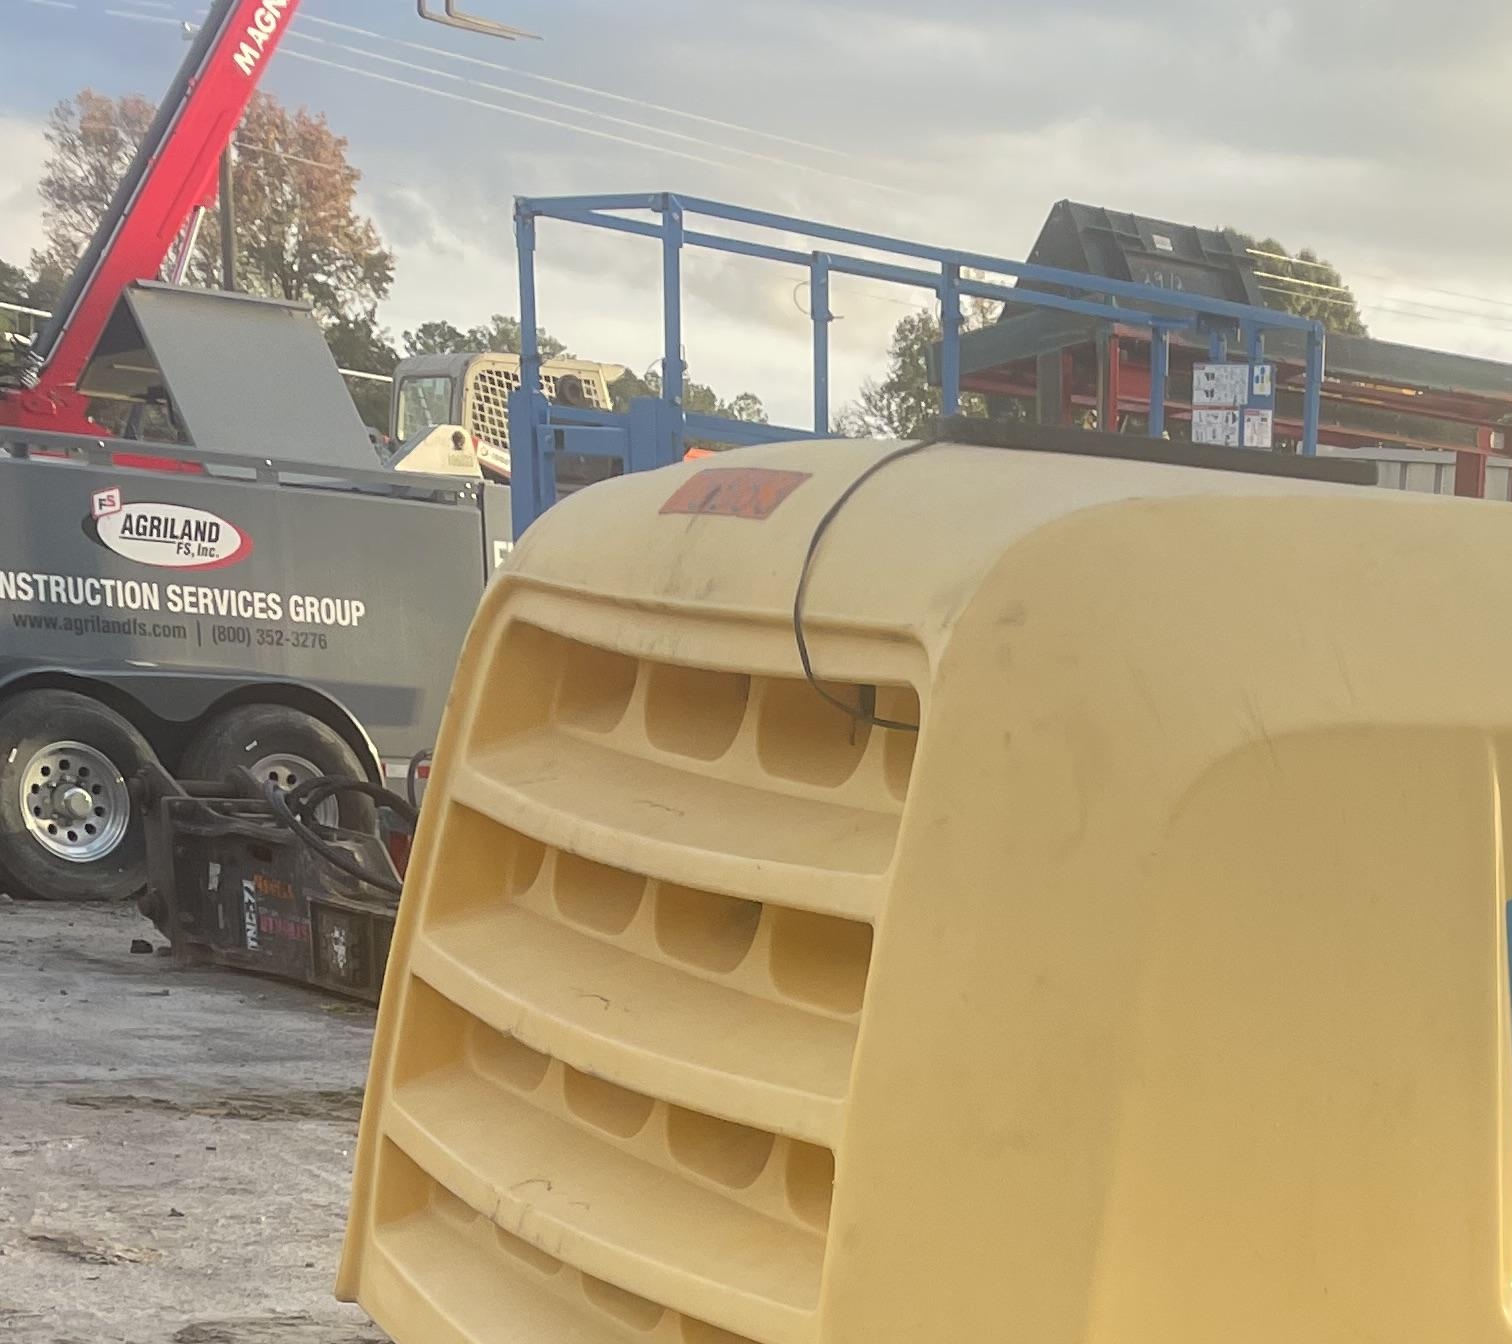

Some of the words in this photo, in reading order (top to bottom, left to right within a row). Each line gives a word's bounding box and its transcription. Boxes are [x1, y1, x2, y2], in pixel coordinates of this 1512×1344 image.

[98, 495, 115, 510] FS
[121, 513, 221, 543] AGRILAND
[197, 543, 220, 559] Inc.
[0, 571, 160, 612] NSTRUCTION
[167, 583, 283, 622] SERVICES
[289, 594, 366, 627] GROUP
[12, 612, 187, 640] www.agrilandfs.com
[211, 624, 251, 648] (800)
[256, 627, 328, 650] 352-3276
